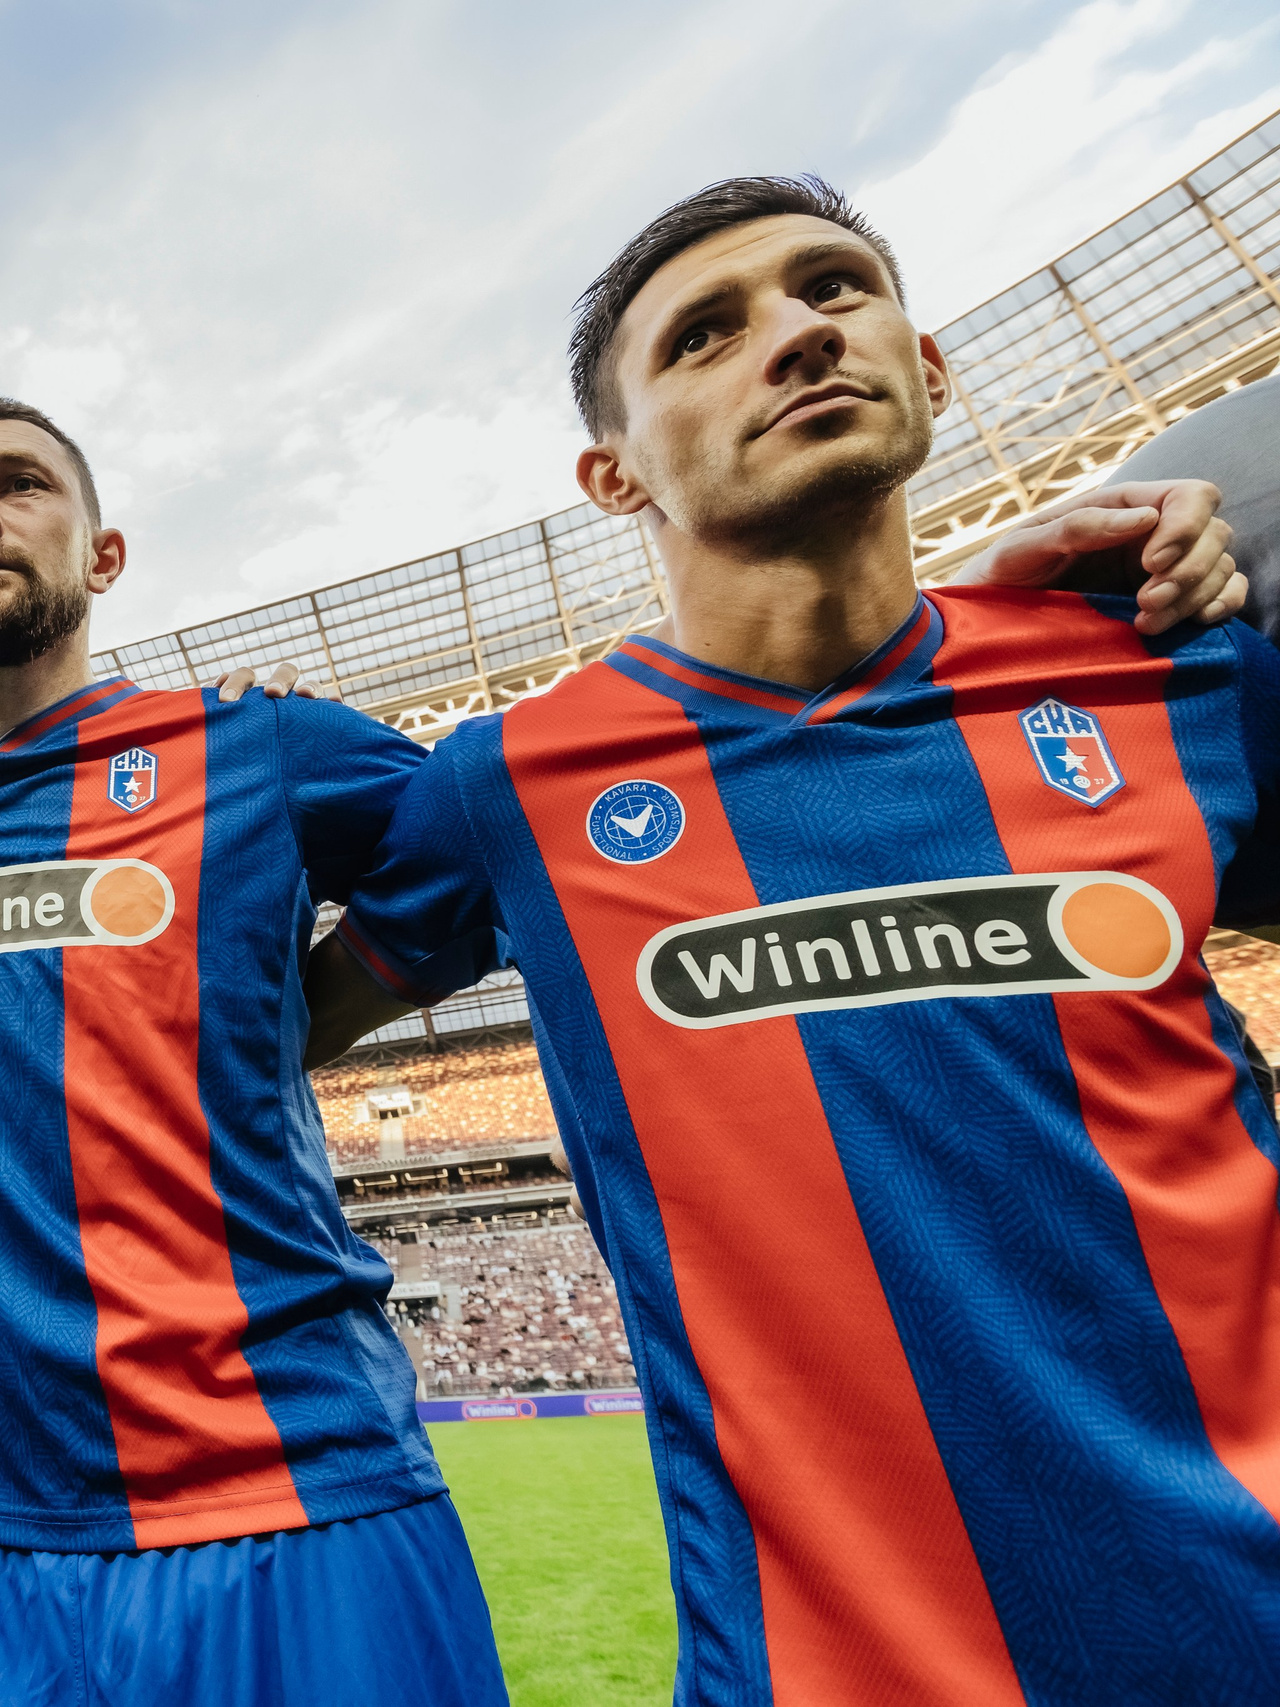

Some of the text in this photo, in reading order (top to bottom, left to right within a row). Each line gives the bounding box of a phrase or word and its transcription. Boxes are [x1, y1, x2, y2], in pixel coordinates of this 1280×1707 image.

[604, 784, 647, 802] KAVARA
[591, 793, 681, 860] FUNCTIONAL SPORTSWEAR
[677, 915, 1032, 1000] Winline
[467, 1403, 516, 1417] Winline
[590, 1398, 642, 1412] Winline
